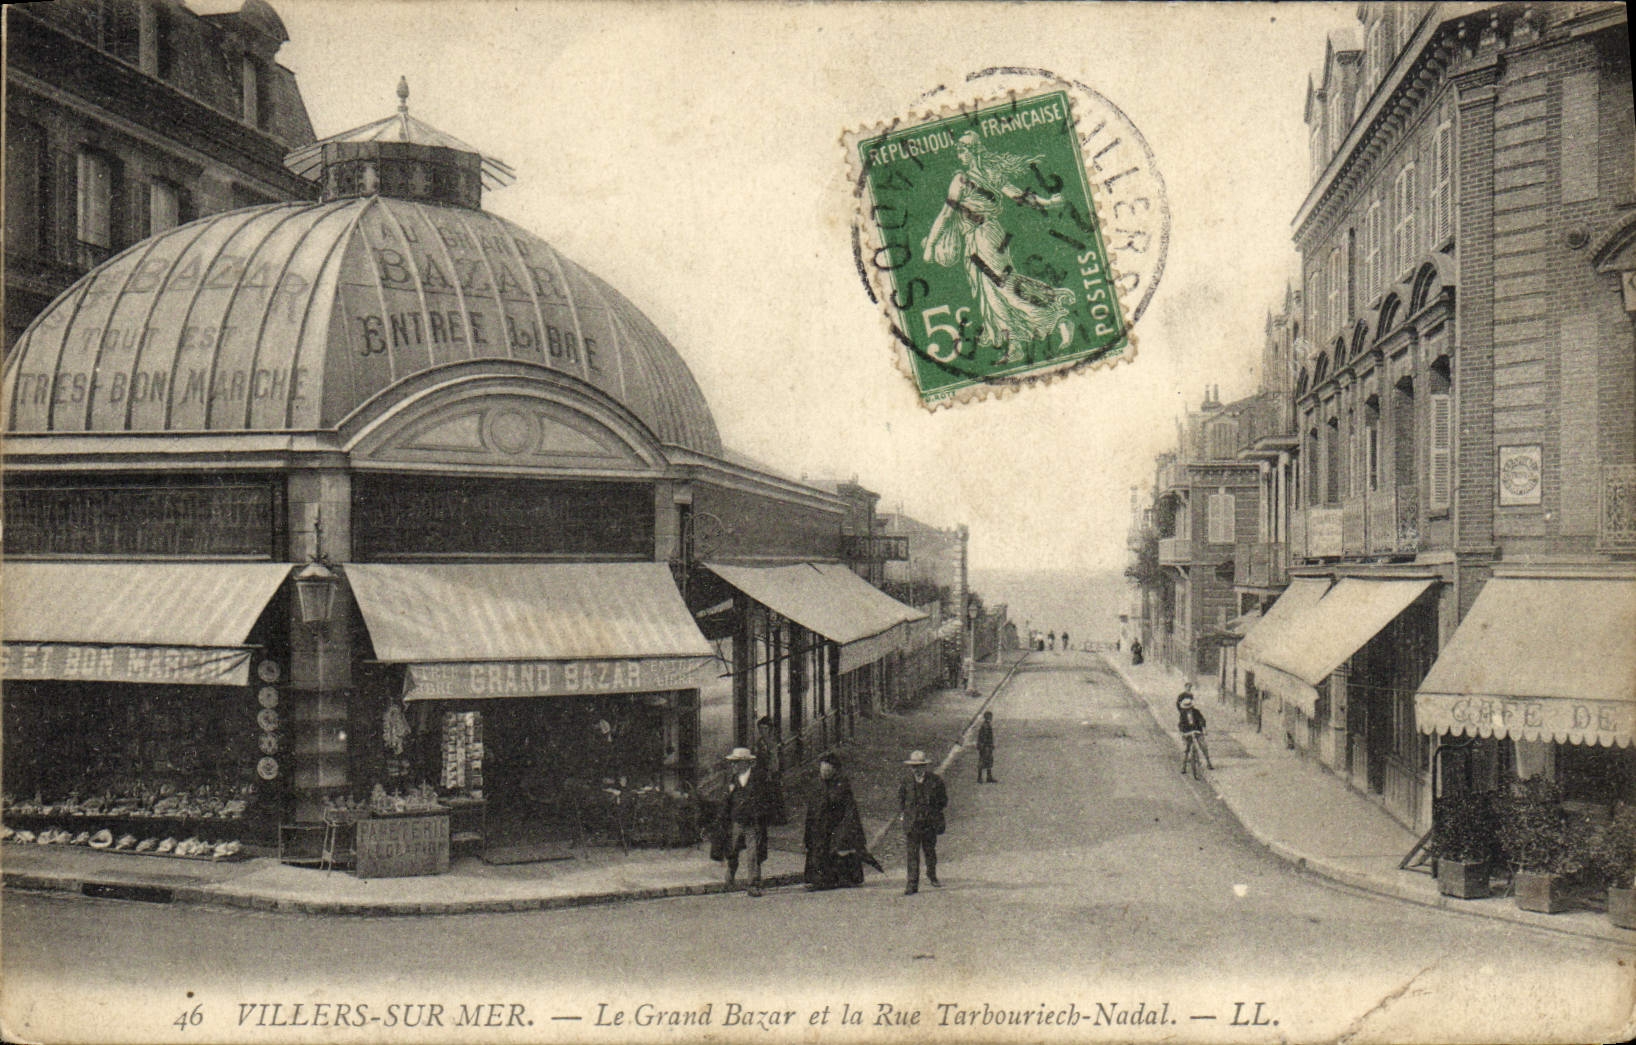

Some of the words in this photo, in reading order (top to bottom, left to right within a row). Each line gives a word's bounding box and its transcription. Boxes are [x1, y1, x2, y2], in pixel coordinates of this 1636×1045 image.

[371, 247, 568, 300] BAZAR
[81, 326, 160, 352] TOUT
[357, 311, 487, 357] ENTREE
[505, 314, 601, 373] LIBRE
[110, 370, 167, 404] BON
[23, 646, 54, 675] ET
[64, 647, 114, 677] BON
[470, 663, 551, 695] GRAND
[564, 661, 641, 692] BAZAR
[1571, 704, 1619, 732] DE
